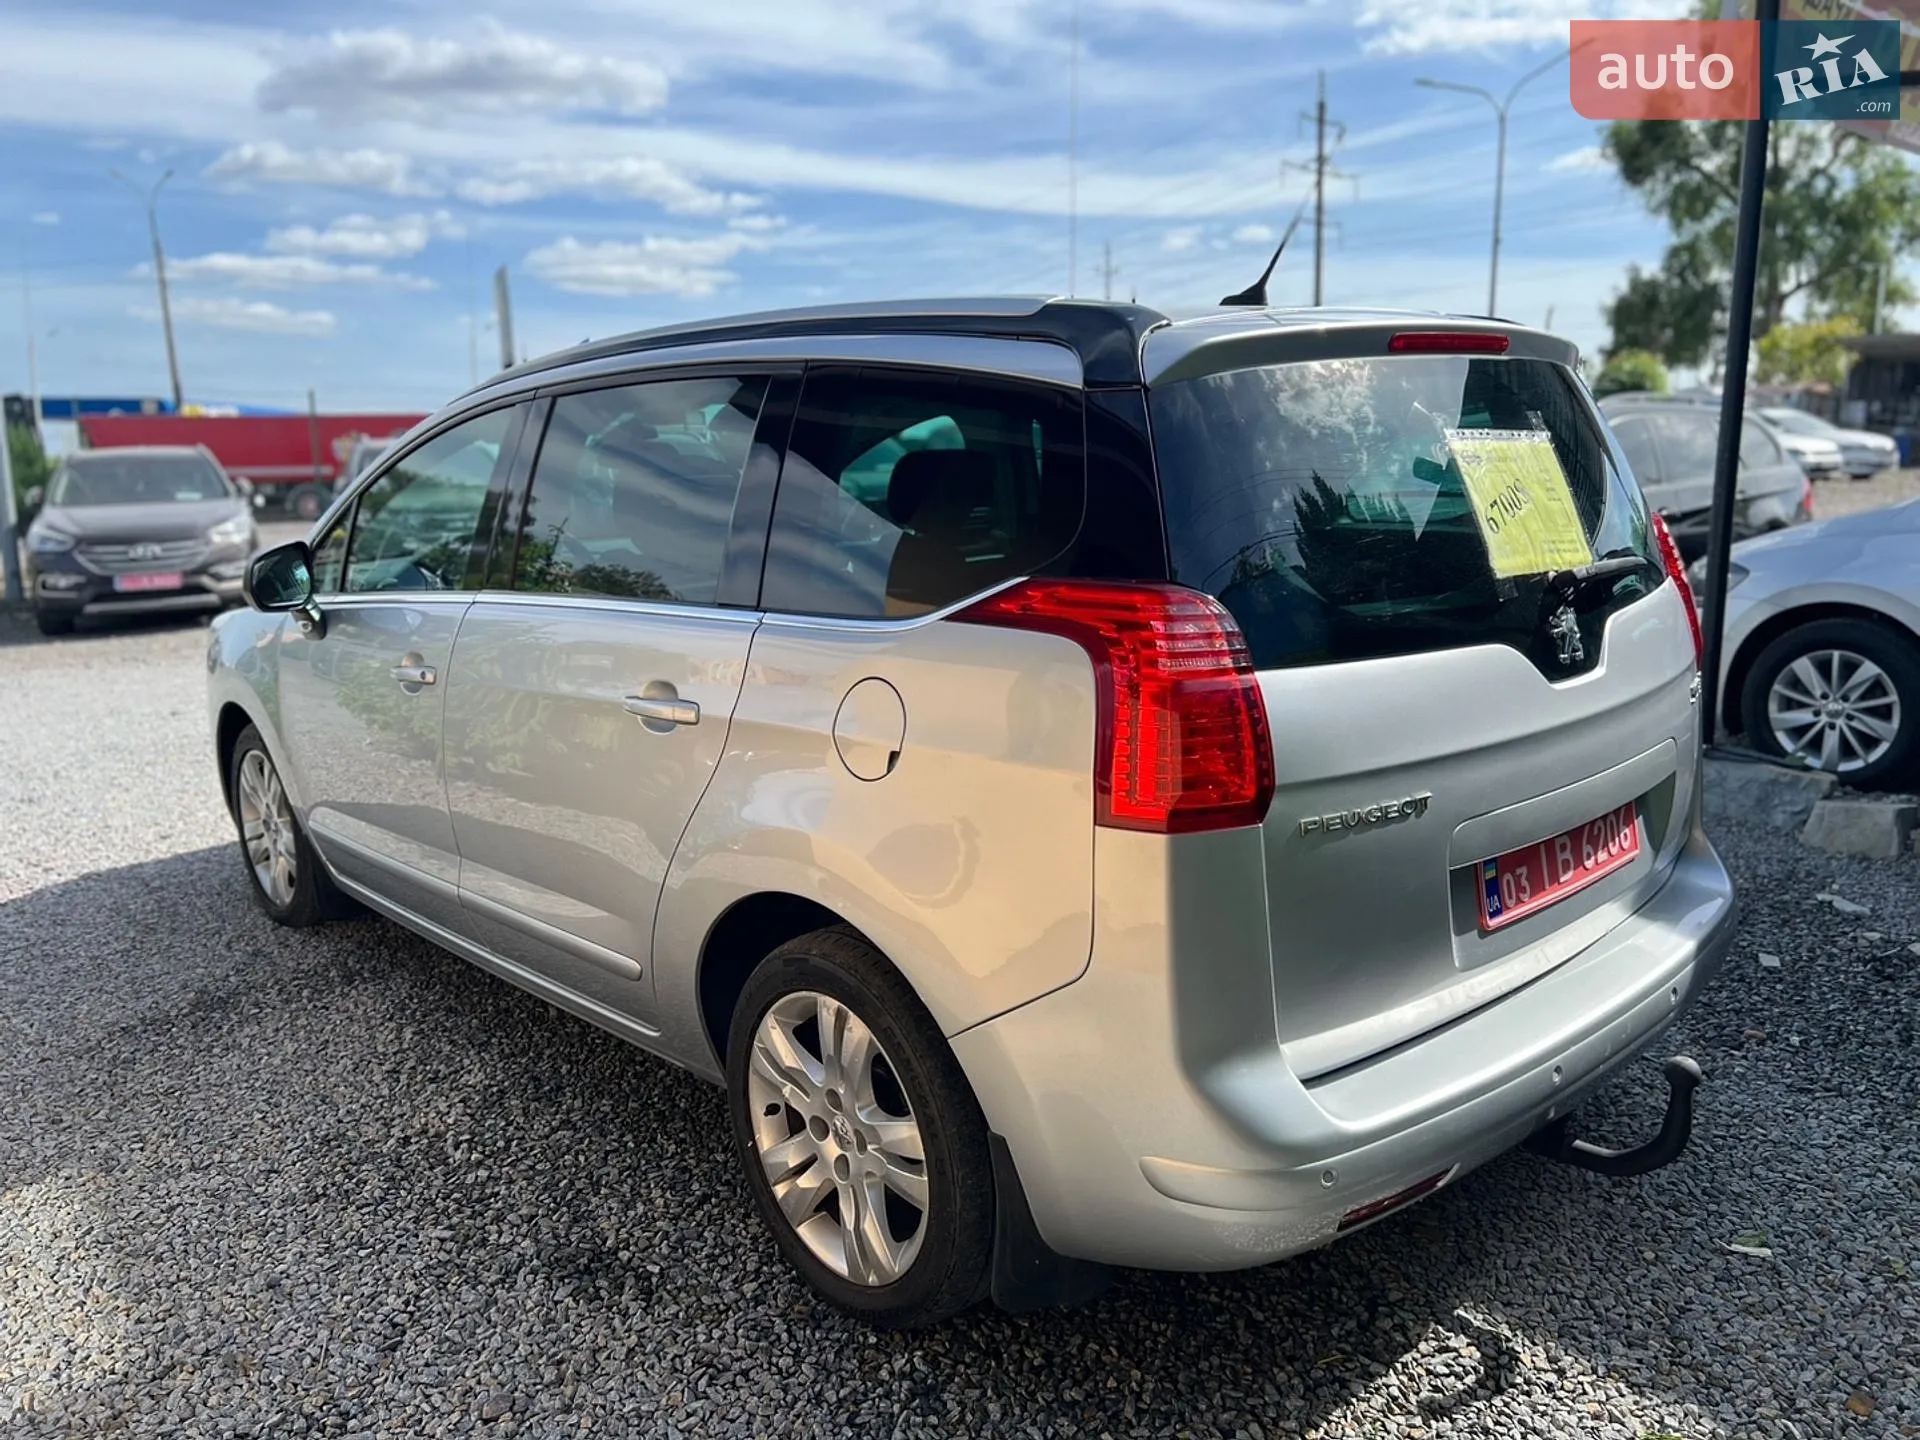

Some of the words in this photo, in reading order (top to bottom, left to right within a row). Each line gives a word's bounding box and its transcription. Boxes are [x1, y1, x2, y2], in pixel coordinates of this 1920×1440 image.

[1299, 791, 1433, 837] PEUGEOT
[1502, 865, 1531, 909] 03
[1582, 805, 1632, 870] 6206
[1486, 895, 1502, 913] UA
